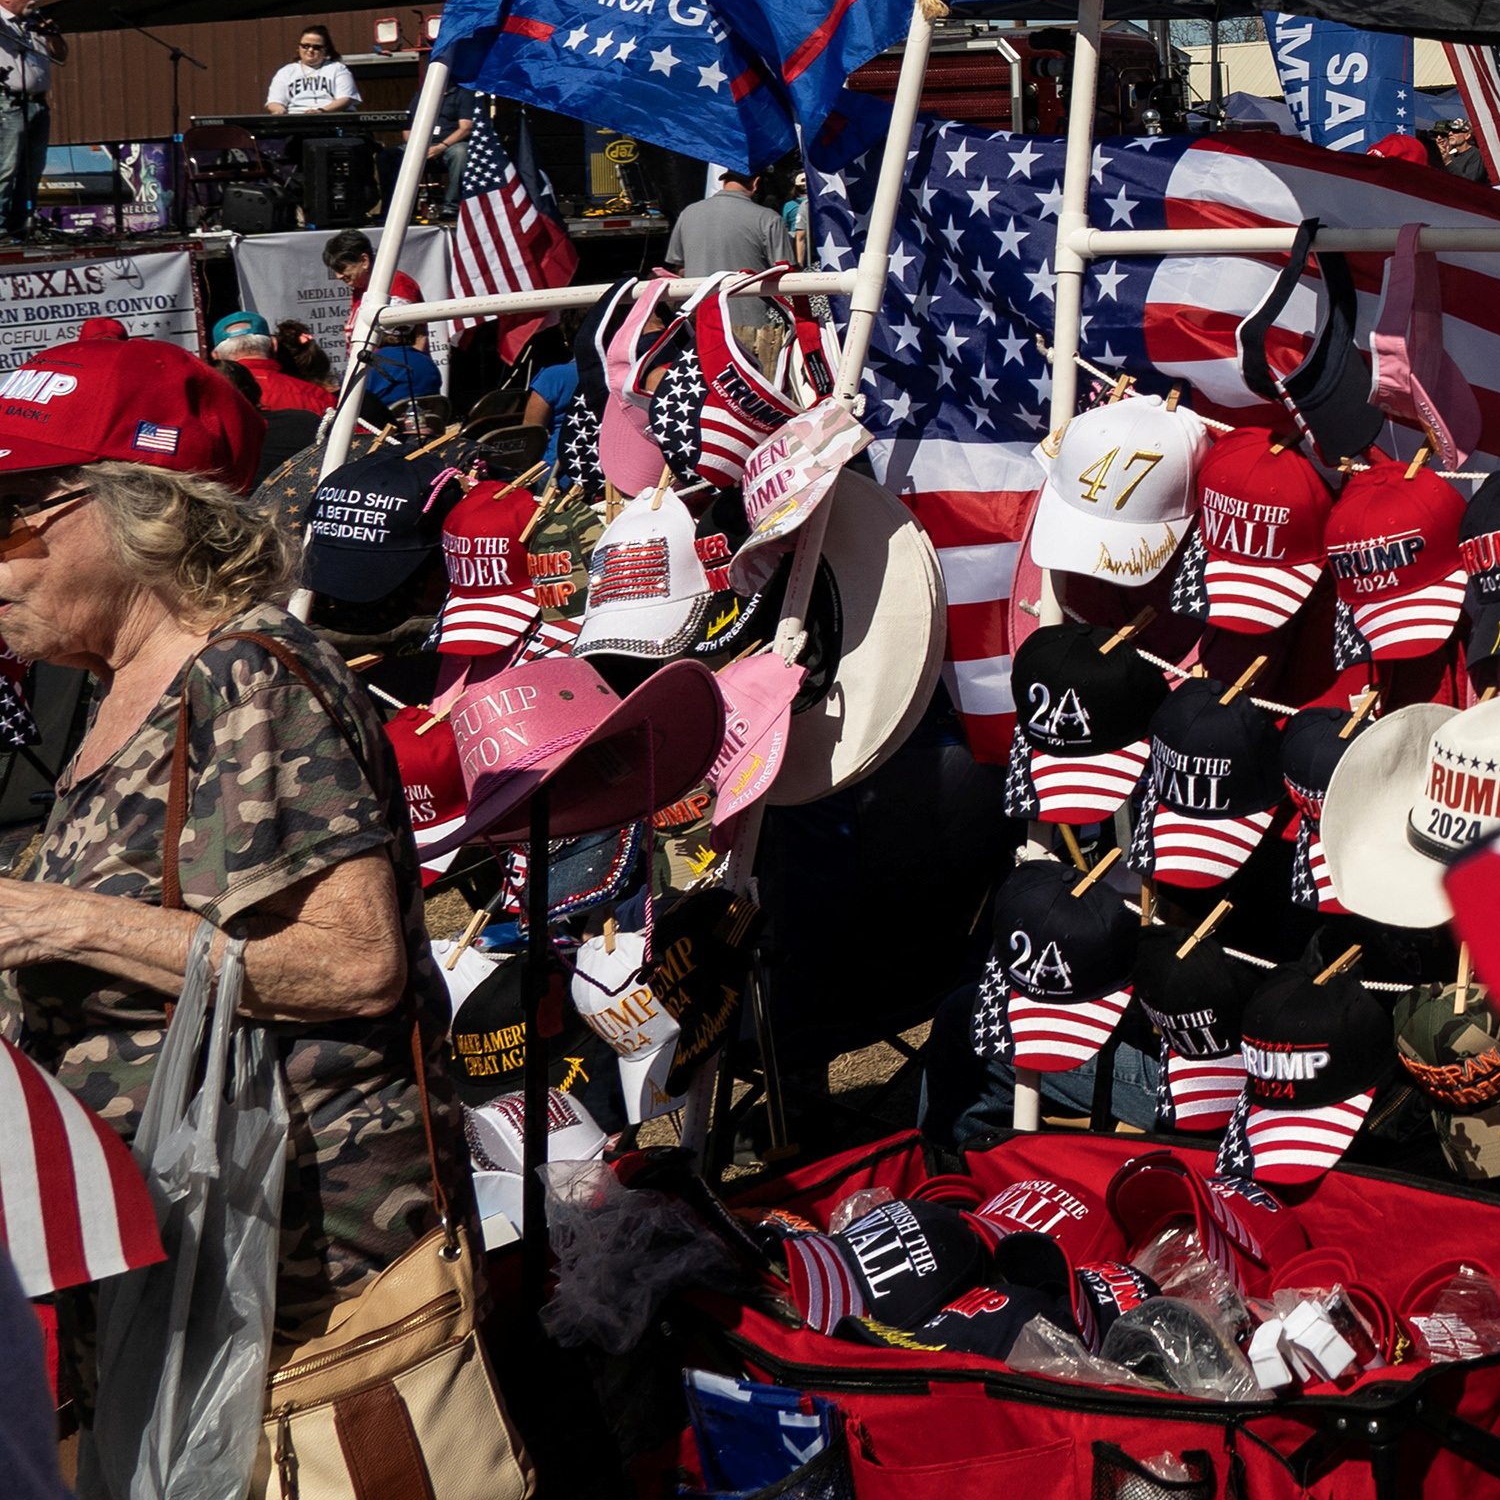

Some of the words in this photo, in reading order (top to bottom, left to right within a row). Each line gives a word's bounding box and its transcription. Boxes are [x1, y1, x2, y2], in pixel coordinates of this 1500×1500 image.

[288, 75, 335, 98] REVIVAL
[23, 301, 101, 321] BORDER
[106, 294, 179, 314] CONVOY
[297, 288, 336, 301] MEDIA
[309, 306, 326, 320] All
[0, 329, 51, 345] CEFUL
[711, 380, 729, 399] KEEP
[725, 399, 753, 424] AMERICA
[1078, 446, 1163, 510] 47
[319, 486, 361, 505] COULD
[365, 492, 408, 512] SHIT
[325, 507, 387, 527] BETTER
[1203, 487, 1247, 519] FINISH
[1253, 503, 1290, 525] THE
[311, 521, 391, 545] PRESIDENT
[474, 536, 511, 556] THE
[1203, 504, 1286, 560] WALL
[1328, 535, 1425, 579] TRUMP
[1353, 572, 1399, 593] 2024
[719, 592, 763, 647] PRESIDENT
[1028, 682, 1091, 736] 2A
[754, 730, 784, 799] PRESIDENT
[1152, 754, 1231, 811] WALL
[1193, 757, 1231, 777] THE
[1427, 808, 1482, 844] 2024
[1009, 930, 1072, 989] 2A
[1177, 1008, 1218, 1030] THE
[1241, 1041, 1331, 1080] TRUMP
[1254, 1079, 1295, 1100] 2024
[979, 1187, 1071, 1238] WALL
[1053, 1185, 1089, 1222] THE
[841, 1205, 914, 1300] WALL
[880, 1199, 919, 1242] FINISH
[905, 1237, 938, 1278] THE
